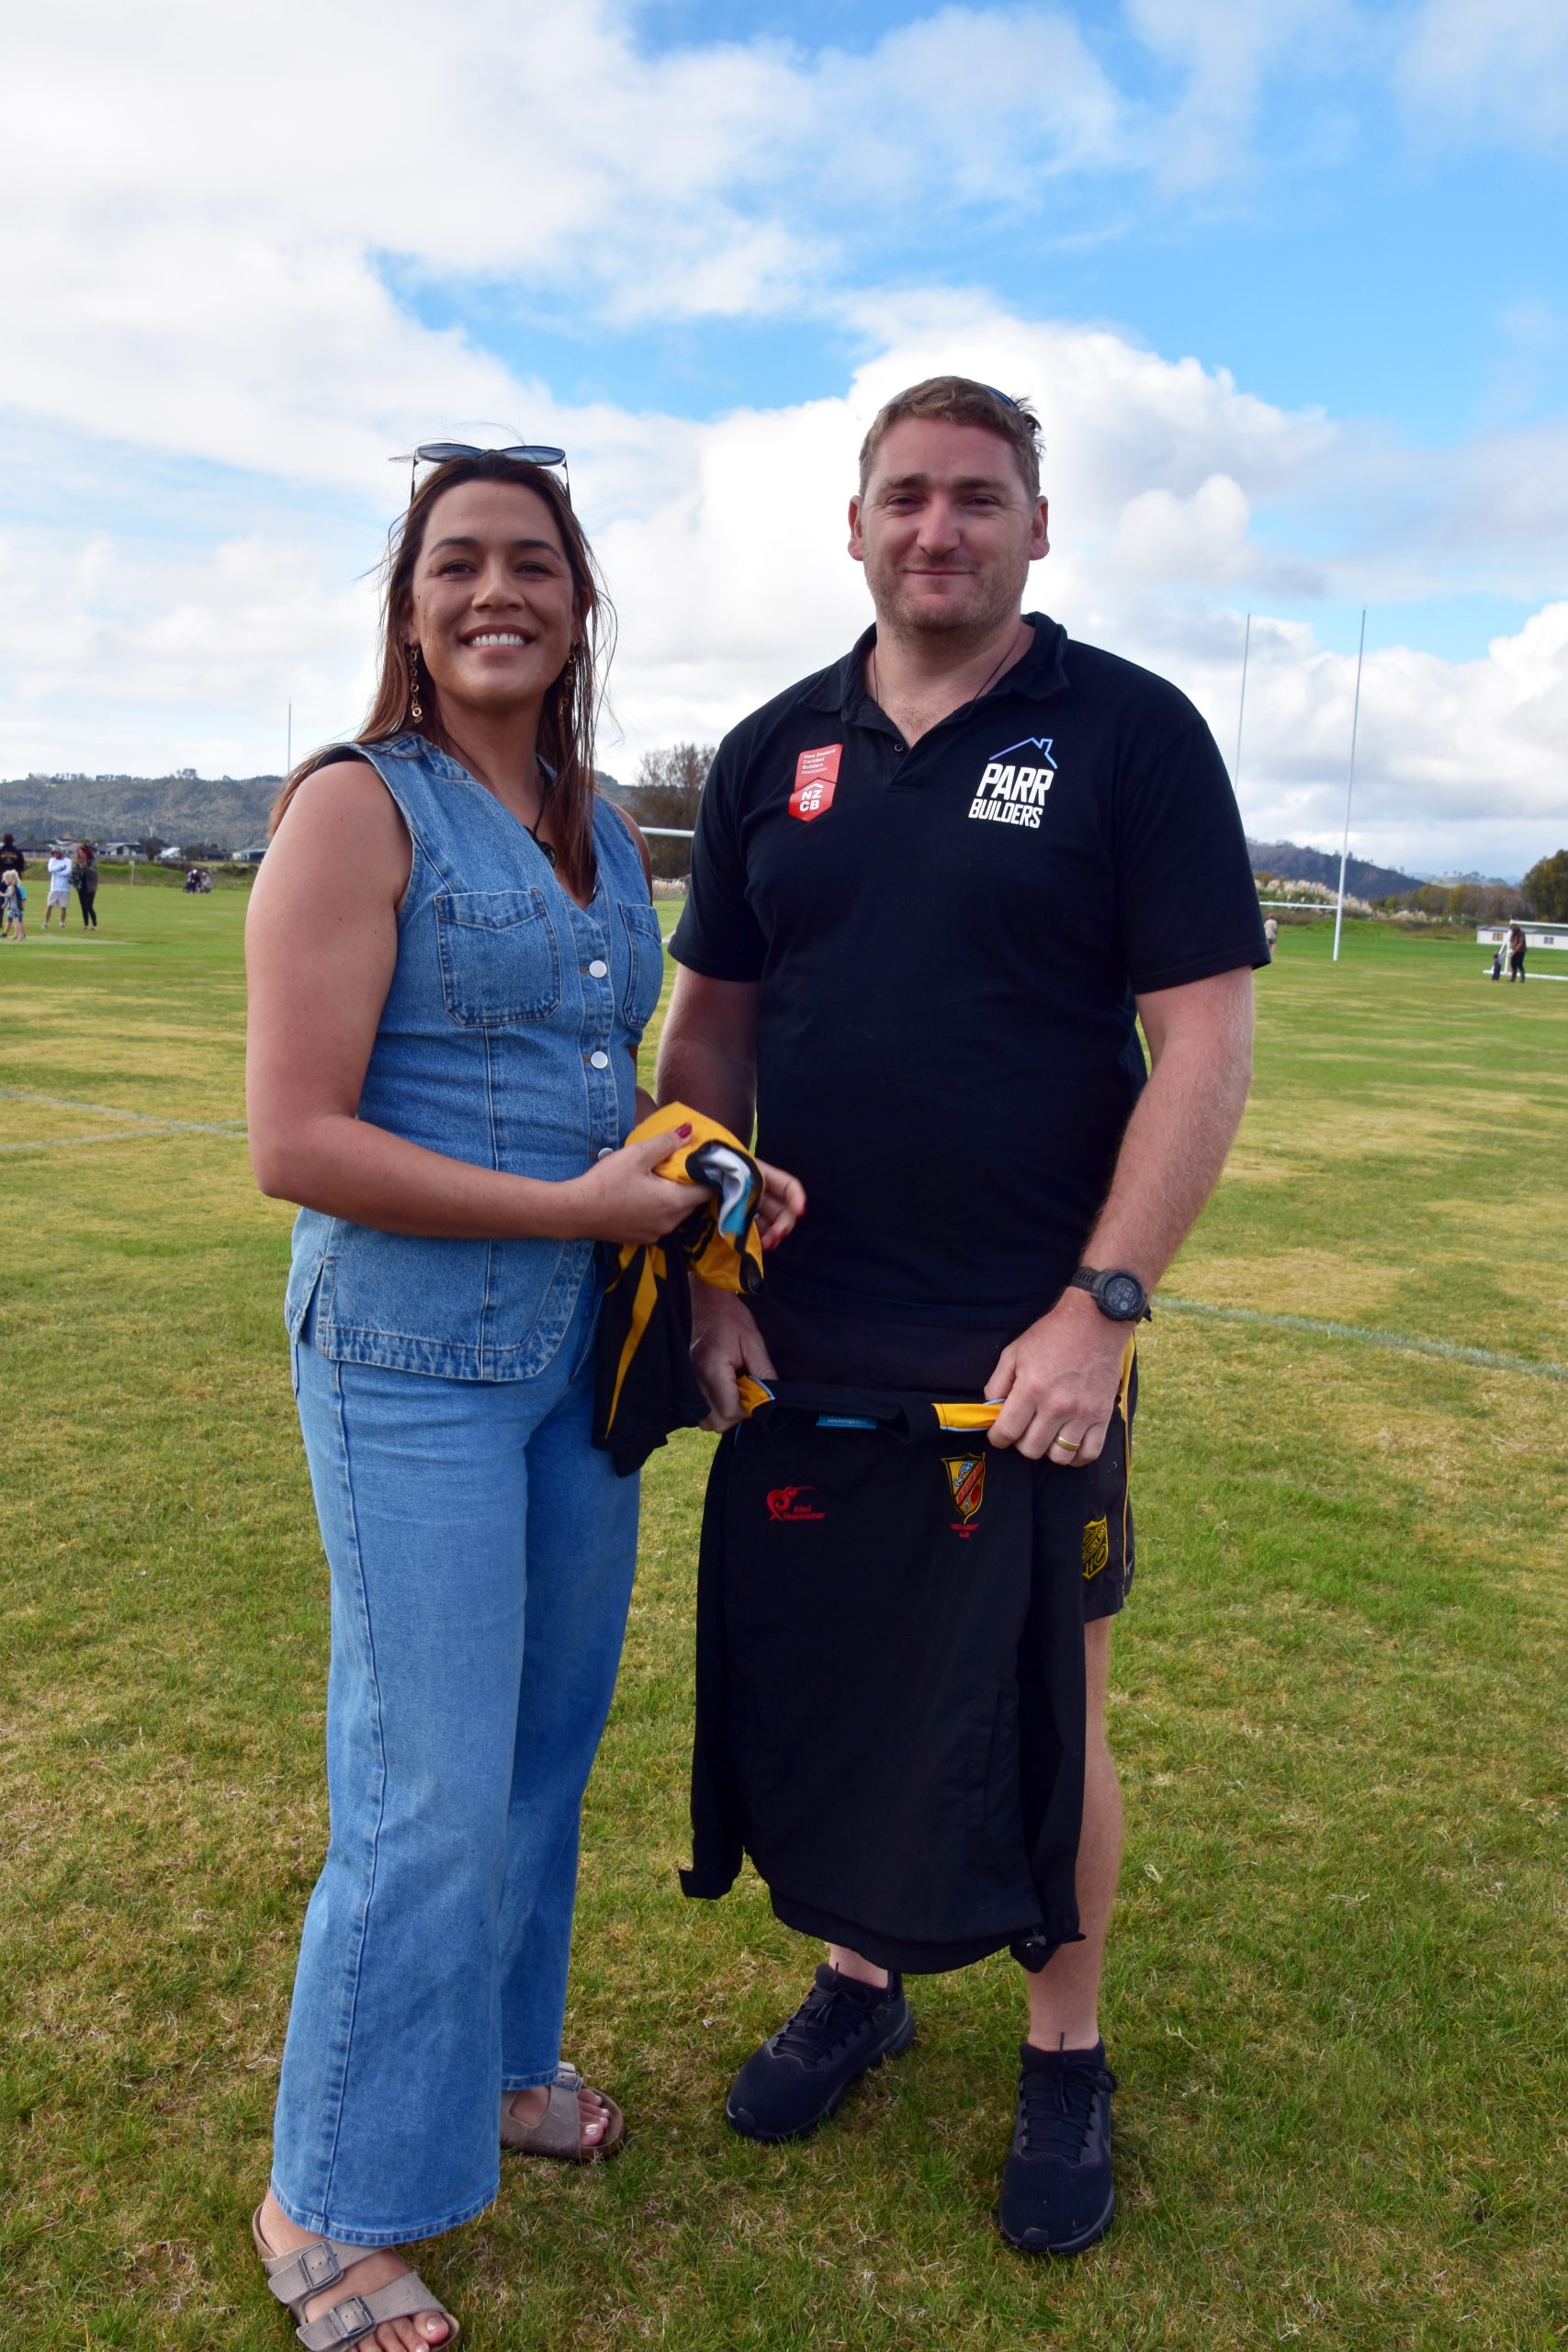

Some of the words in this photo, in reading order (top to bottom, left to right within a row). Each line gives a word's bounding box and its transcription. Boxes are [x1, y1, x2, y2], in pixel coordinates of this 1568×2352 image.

[976, 763, 1055, 807] PARR
[801, 789, 822, 800] NZ
[799, 799, 819, 812] CB
[967, 797, 1043, 829] BUILDERS
[794, 1504, 812, 1513] Kiwi
[783, 1512, 825, 1521] Teamwear
[1082, 1537, 1100, 1560] RCURY
